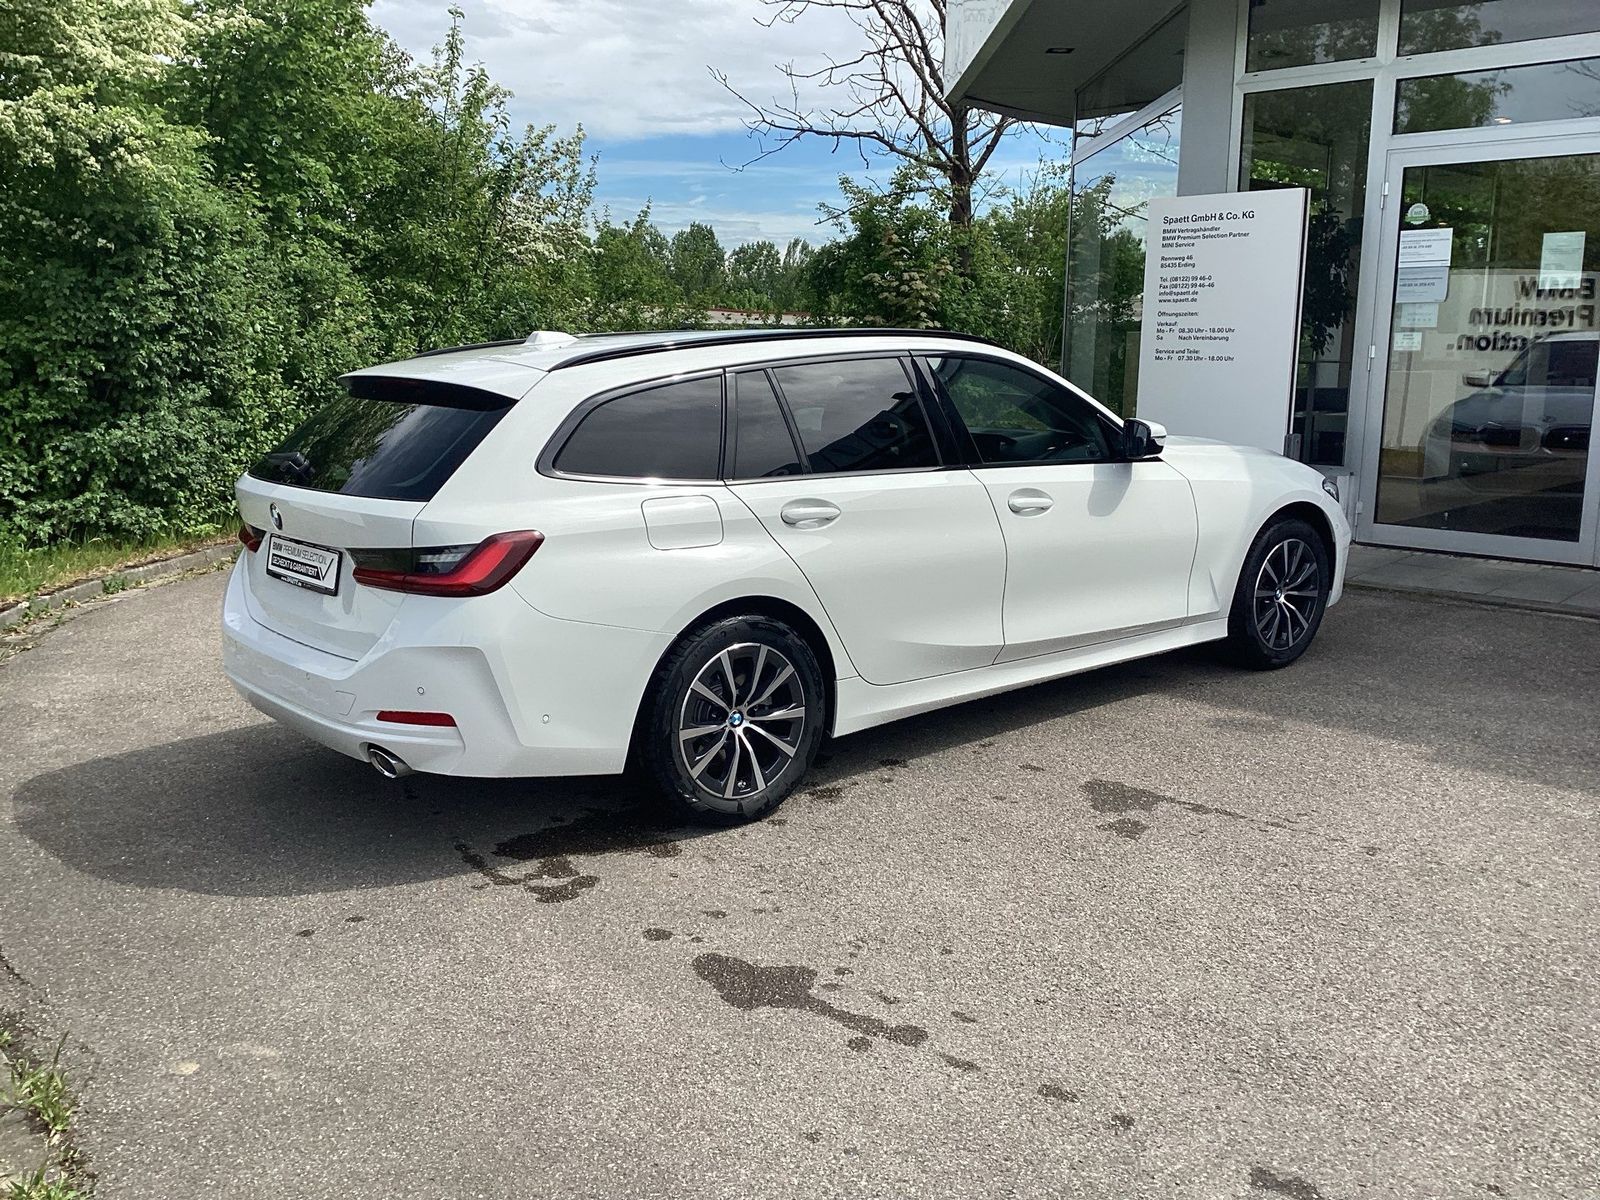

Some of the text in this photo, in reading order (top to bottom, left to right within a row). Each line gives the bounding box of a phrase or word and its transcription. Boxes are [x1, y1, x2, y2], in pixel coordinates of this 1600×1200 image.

[1163, 216, 1190, 225] Spaett
[1191, 213, 1216, 222] GmbH
[1242, 211, 1255, 219] KG
[272, 541, 282, 551] BMW
[283, 544, 302, 557] PREMIUM
